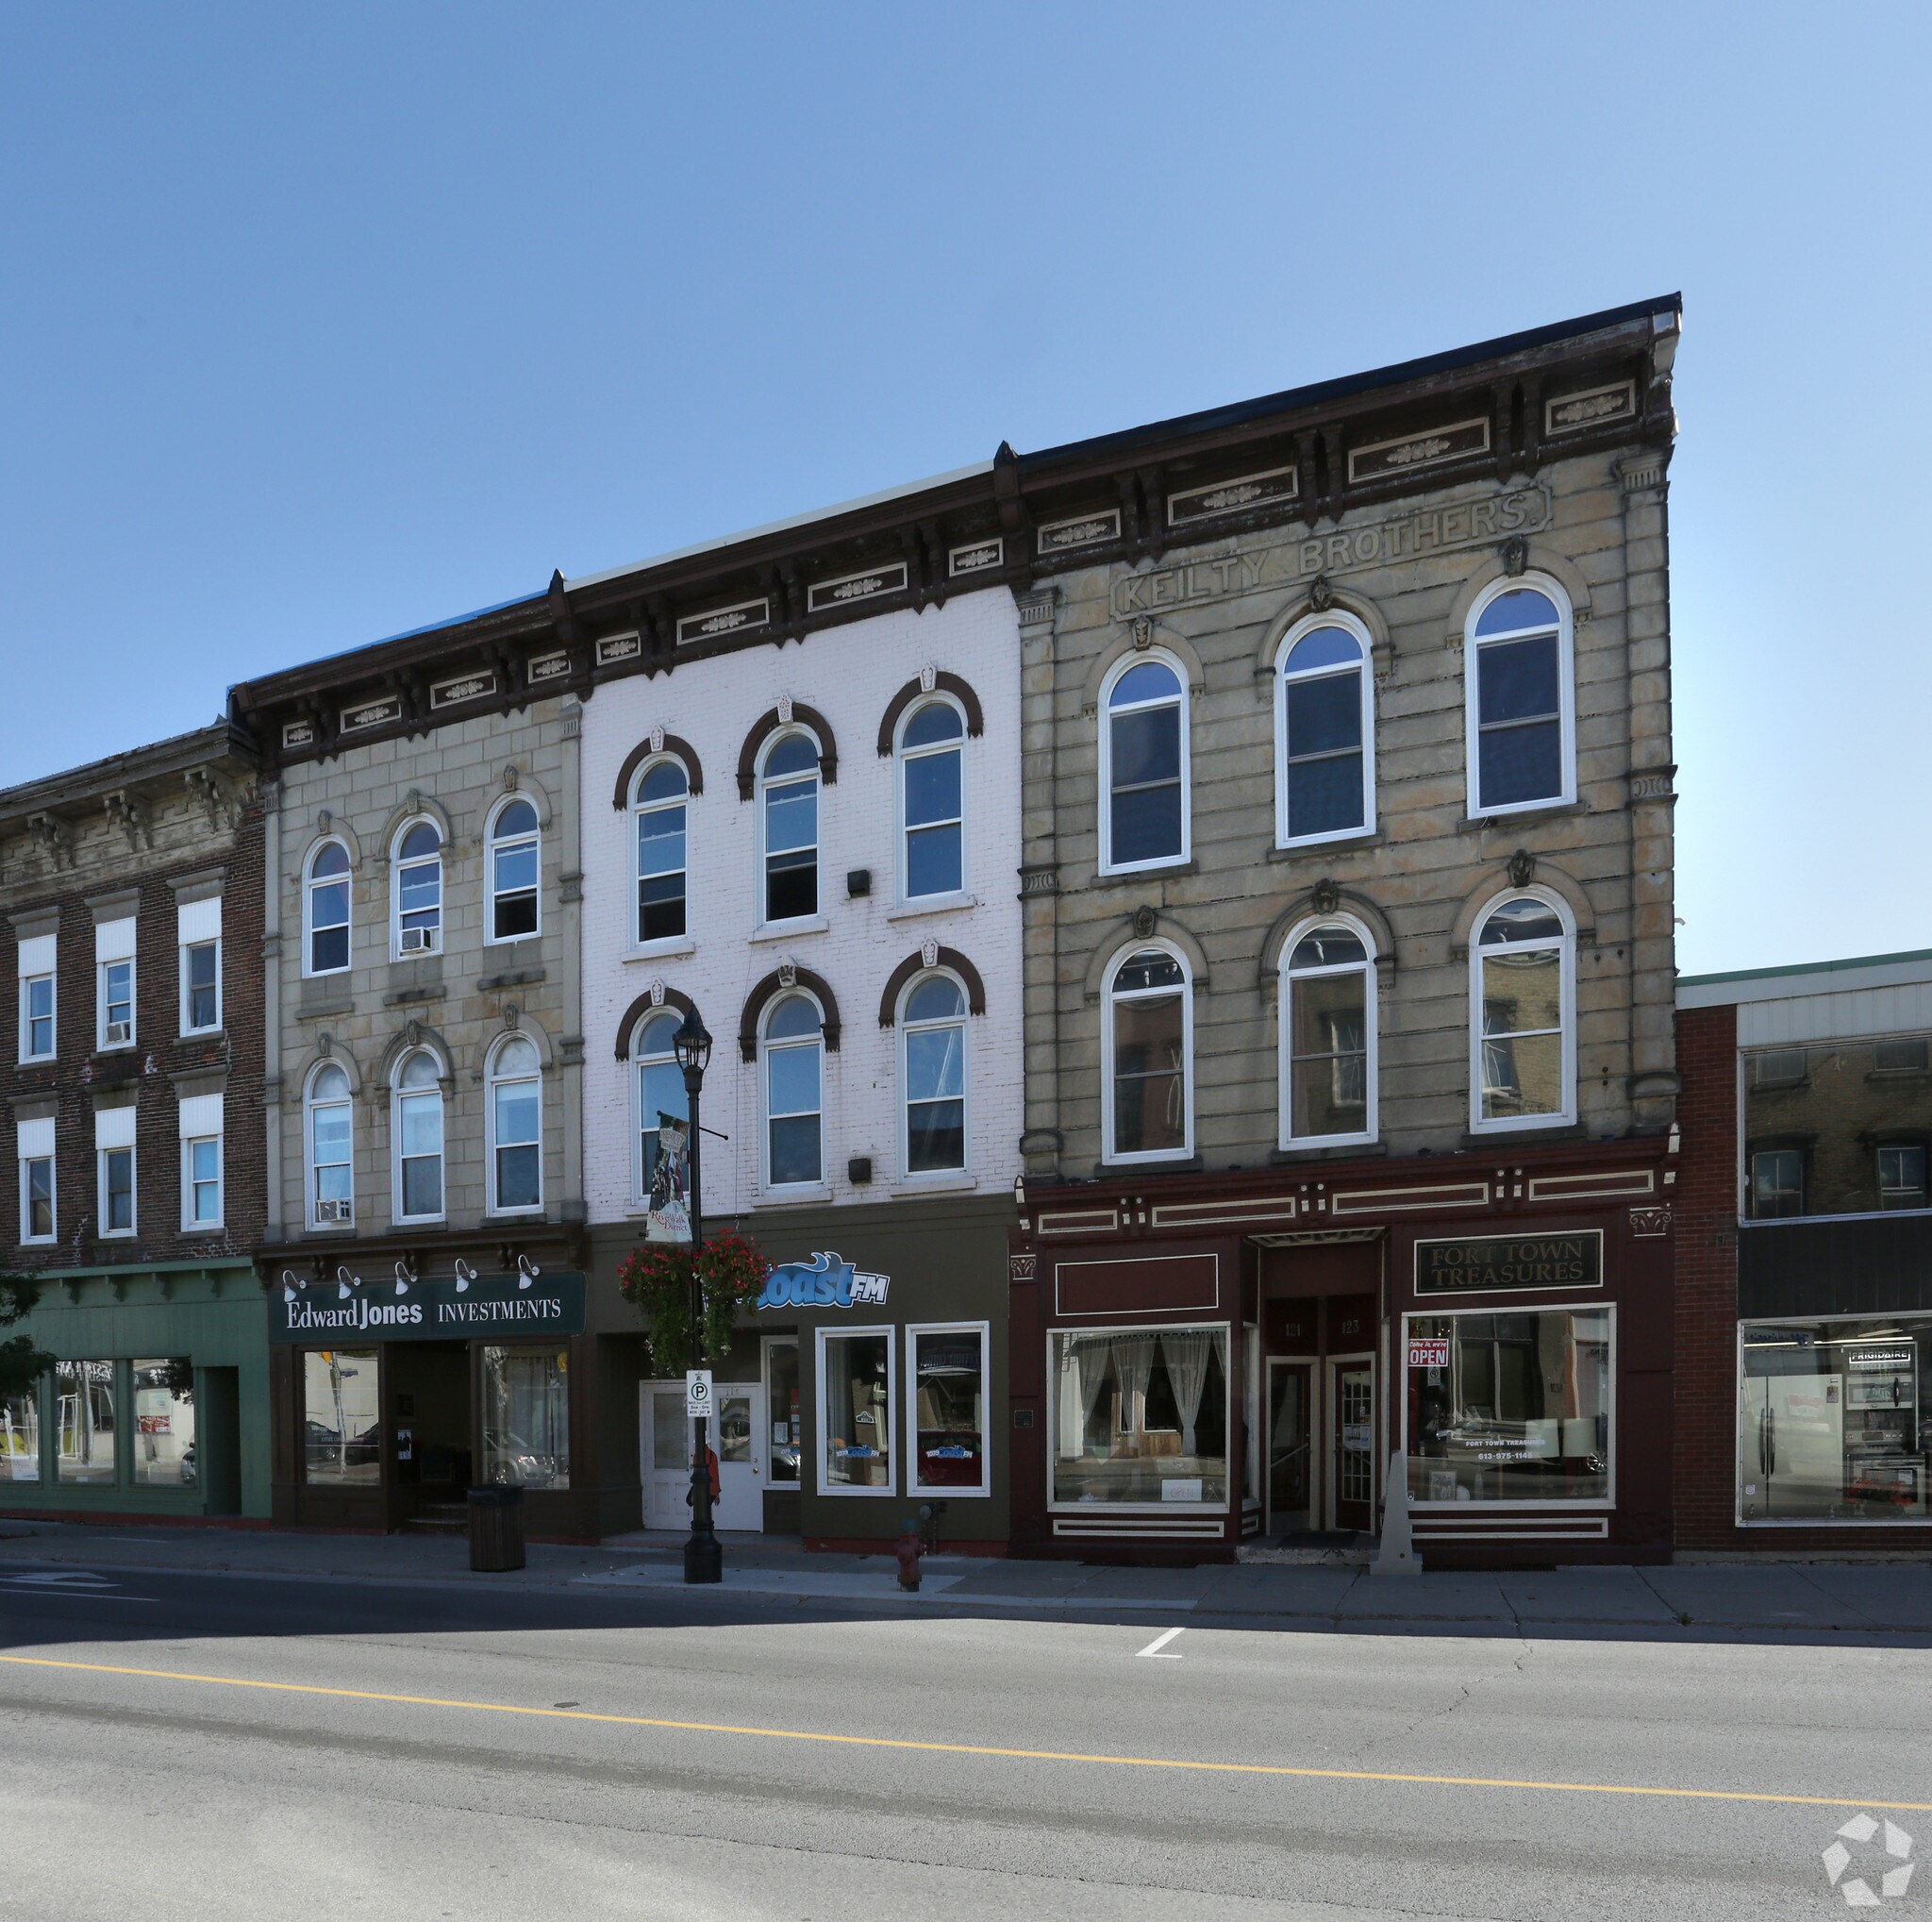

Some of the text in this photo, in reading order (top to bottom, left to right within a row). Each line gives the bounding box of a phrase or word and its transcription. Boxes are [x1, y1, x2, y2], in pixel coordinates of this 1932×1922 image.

[1123, 550, 1270, 613] KEILTY
[1431, 1240, 1584, 1266] FORT TOWN
[758, 1262, 854, 1309] oast
[1431, 1262, 1584, 1286] TREASURES
[438, 1298, 561, 1323] INVESTMENTS
[1409, 1349, 1445, 1364] OPEN
[1852, 1350, 1907, 1360] FRIGIDAIRE
[695, 1385, 705, 1398] P
